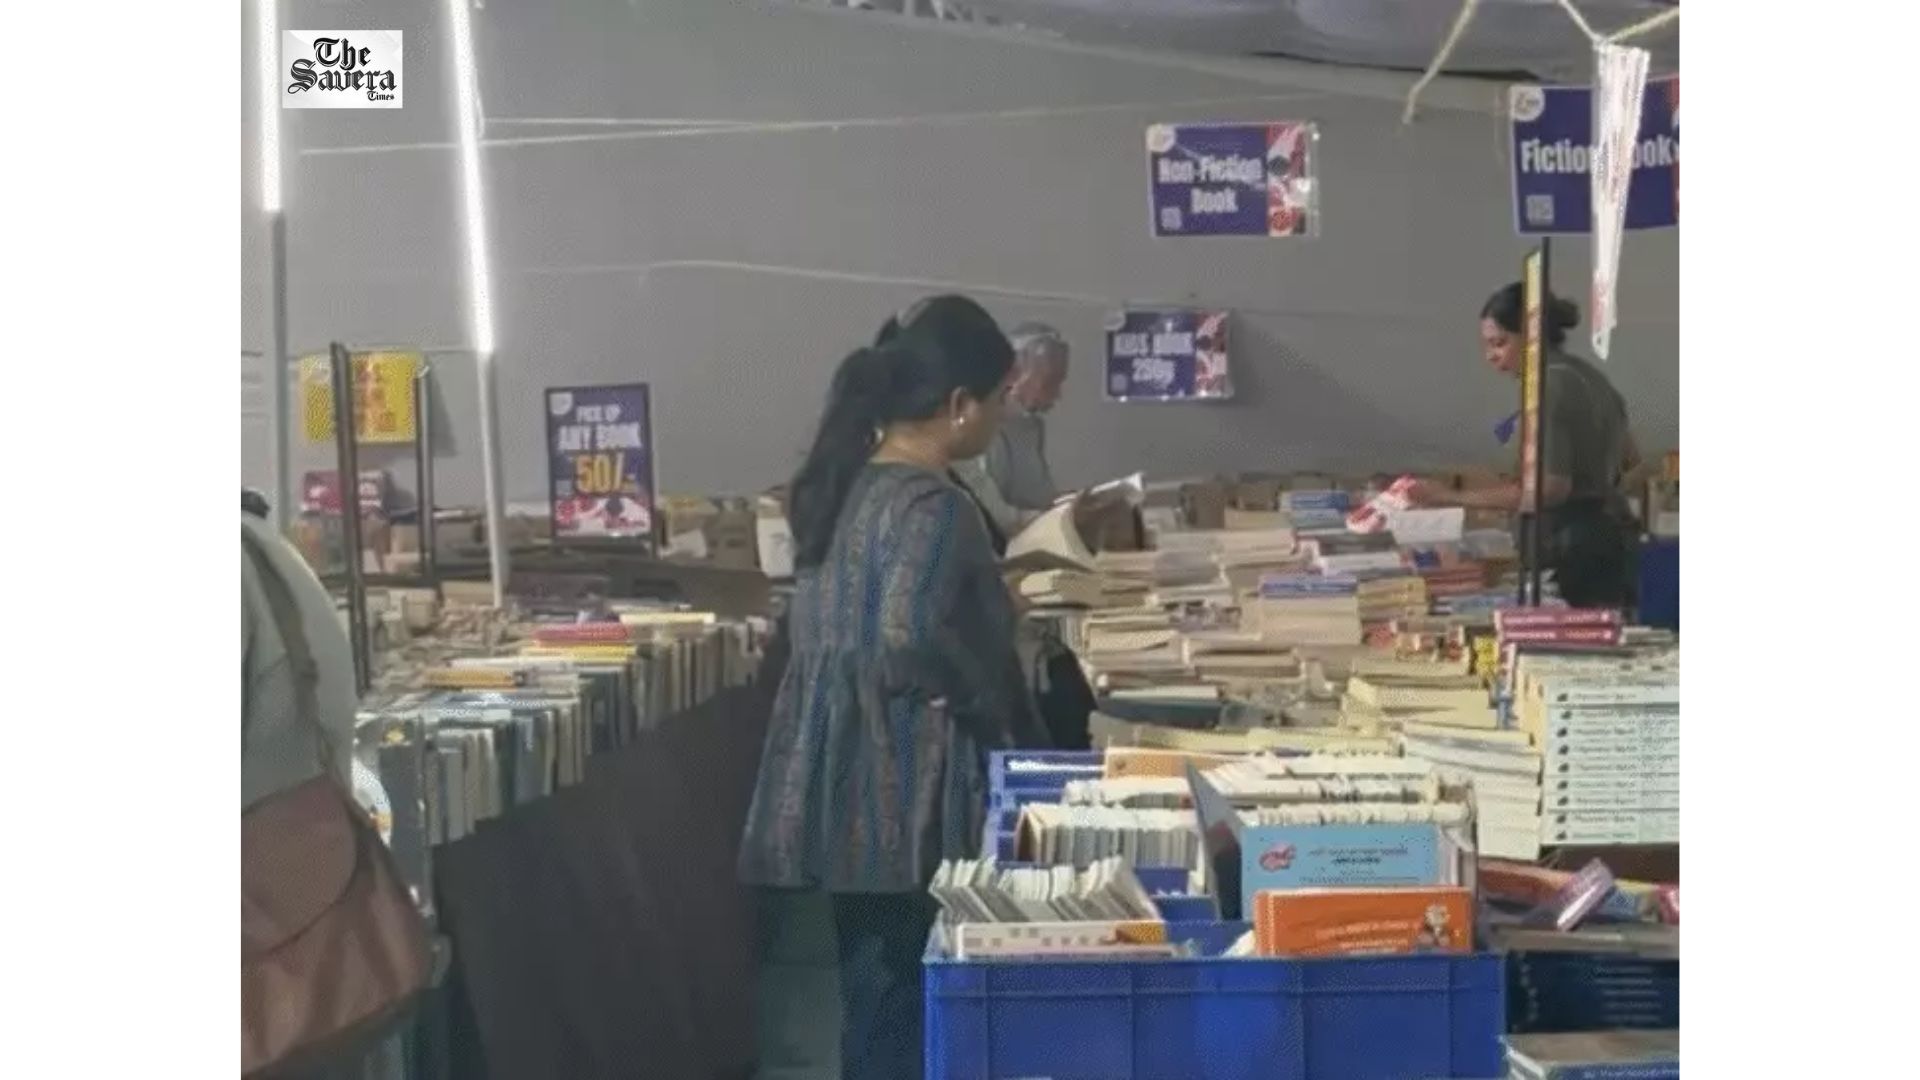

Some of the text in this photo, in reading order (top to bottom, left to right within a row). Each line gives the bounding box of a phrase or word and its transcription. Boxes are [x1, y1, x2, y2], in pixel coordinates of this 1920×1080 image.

[1631, 133, 1673, 170] ook
[1158, 154, 1264, 184] Non-Fiction
[1190, 187, 1239, 214] Book
